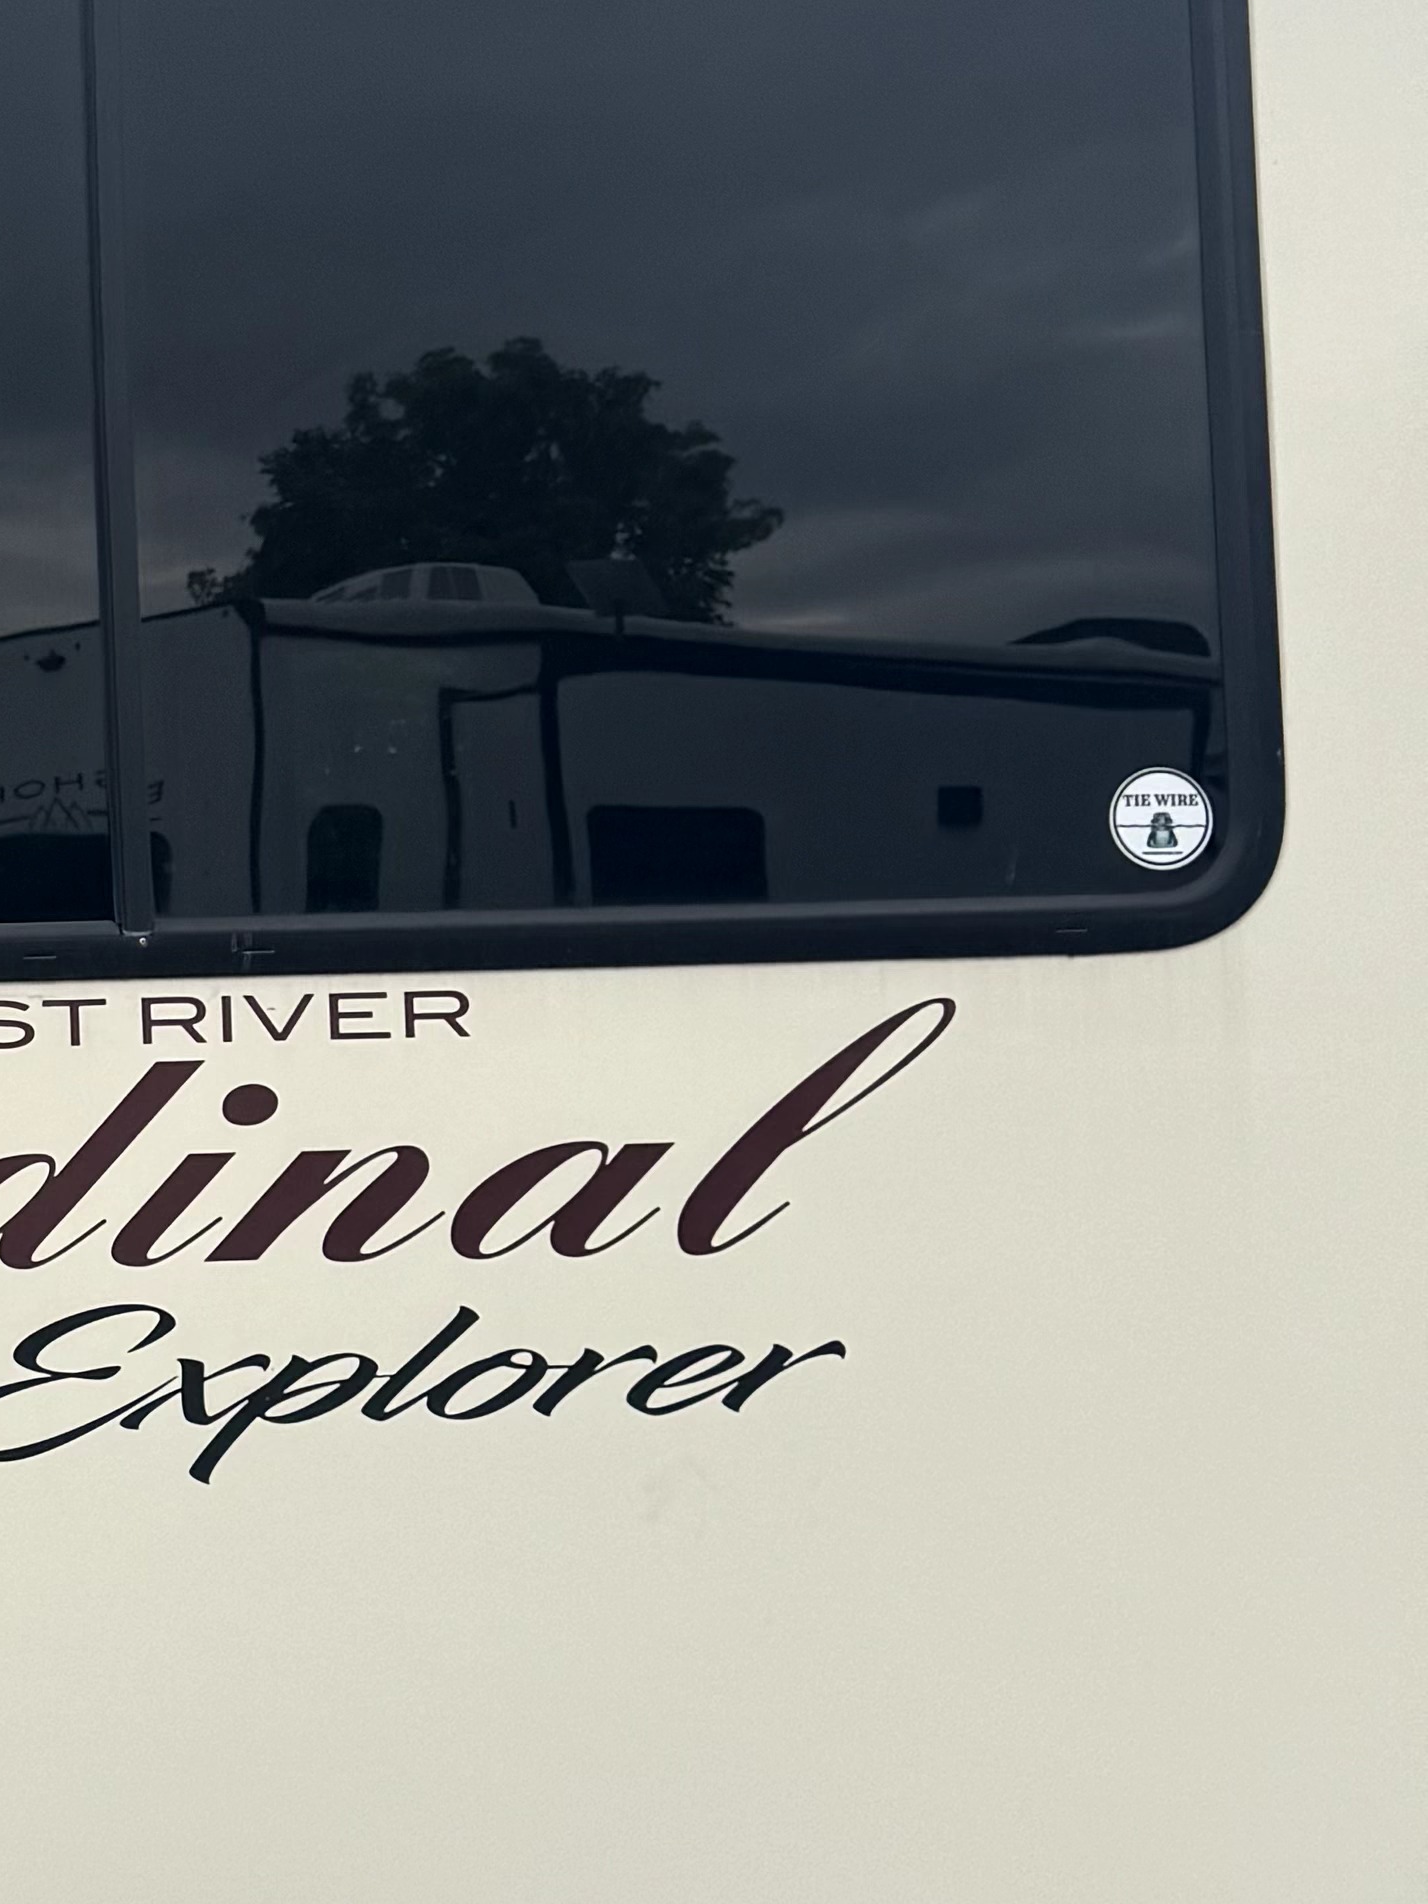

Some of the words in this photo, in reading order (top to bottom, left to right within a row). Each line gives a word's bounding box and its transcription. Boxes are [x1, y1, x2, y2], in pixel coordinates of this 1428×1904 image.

[1122, 793, 1151, 807] TIE
[1153, 793, 1199, 807] WIRE
[140, 990, 471, 1045] RIVER
